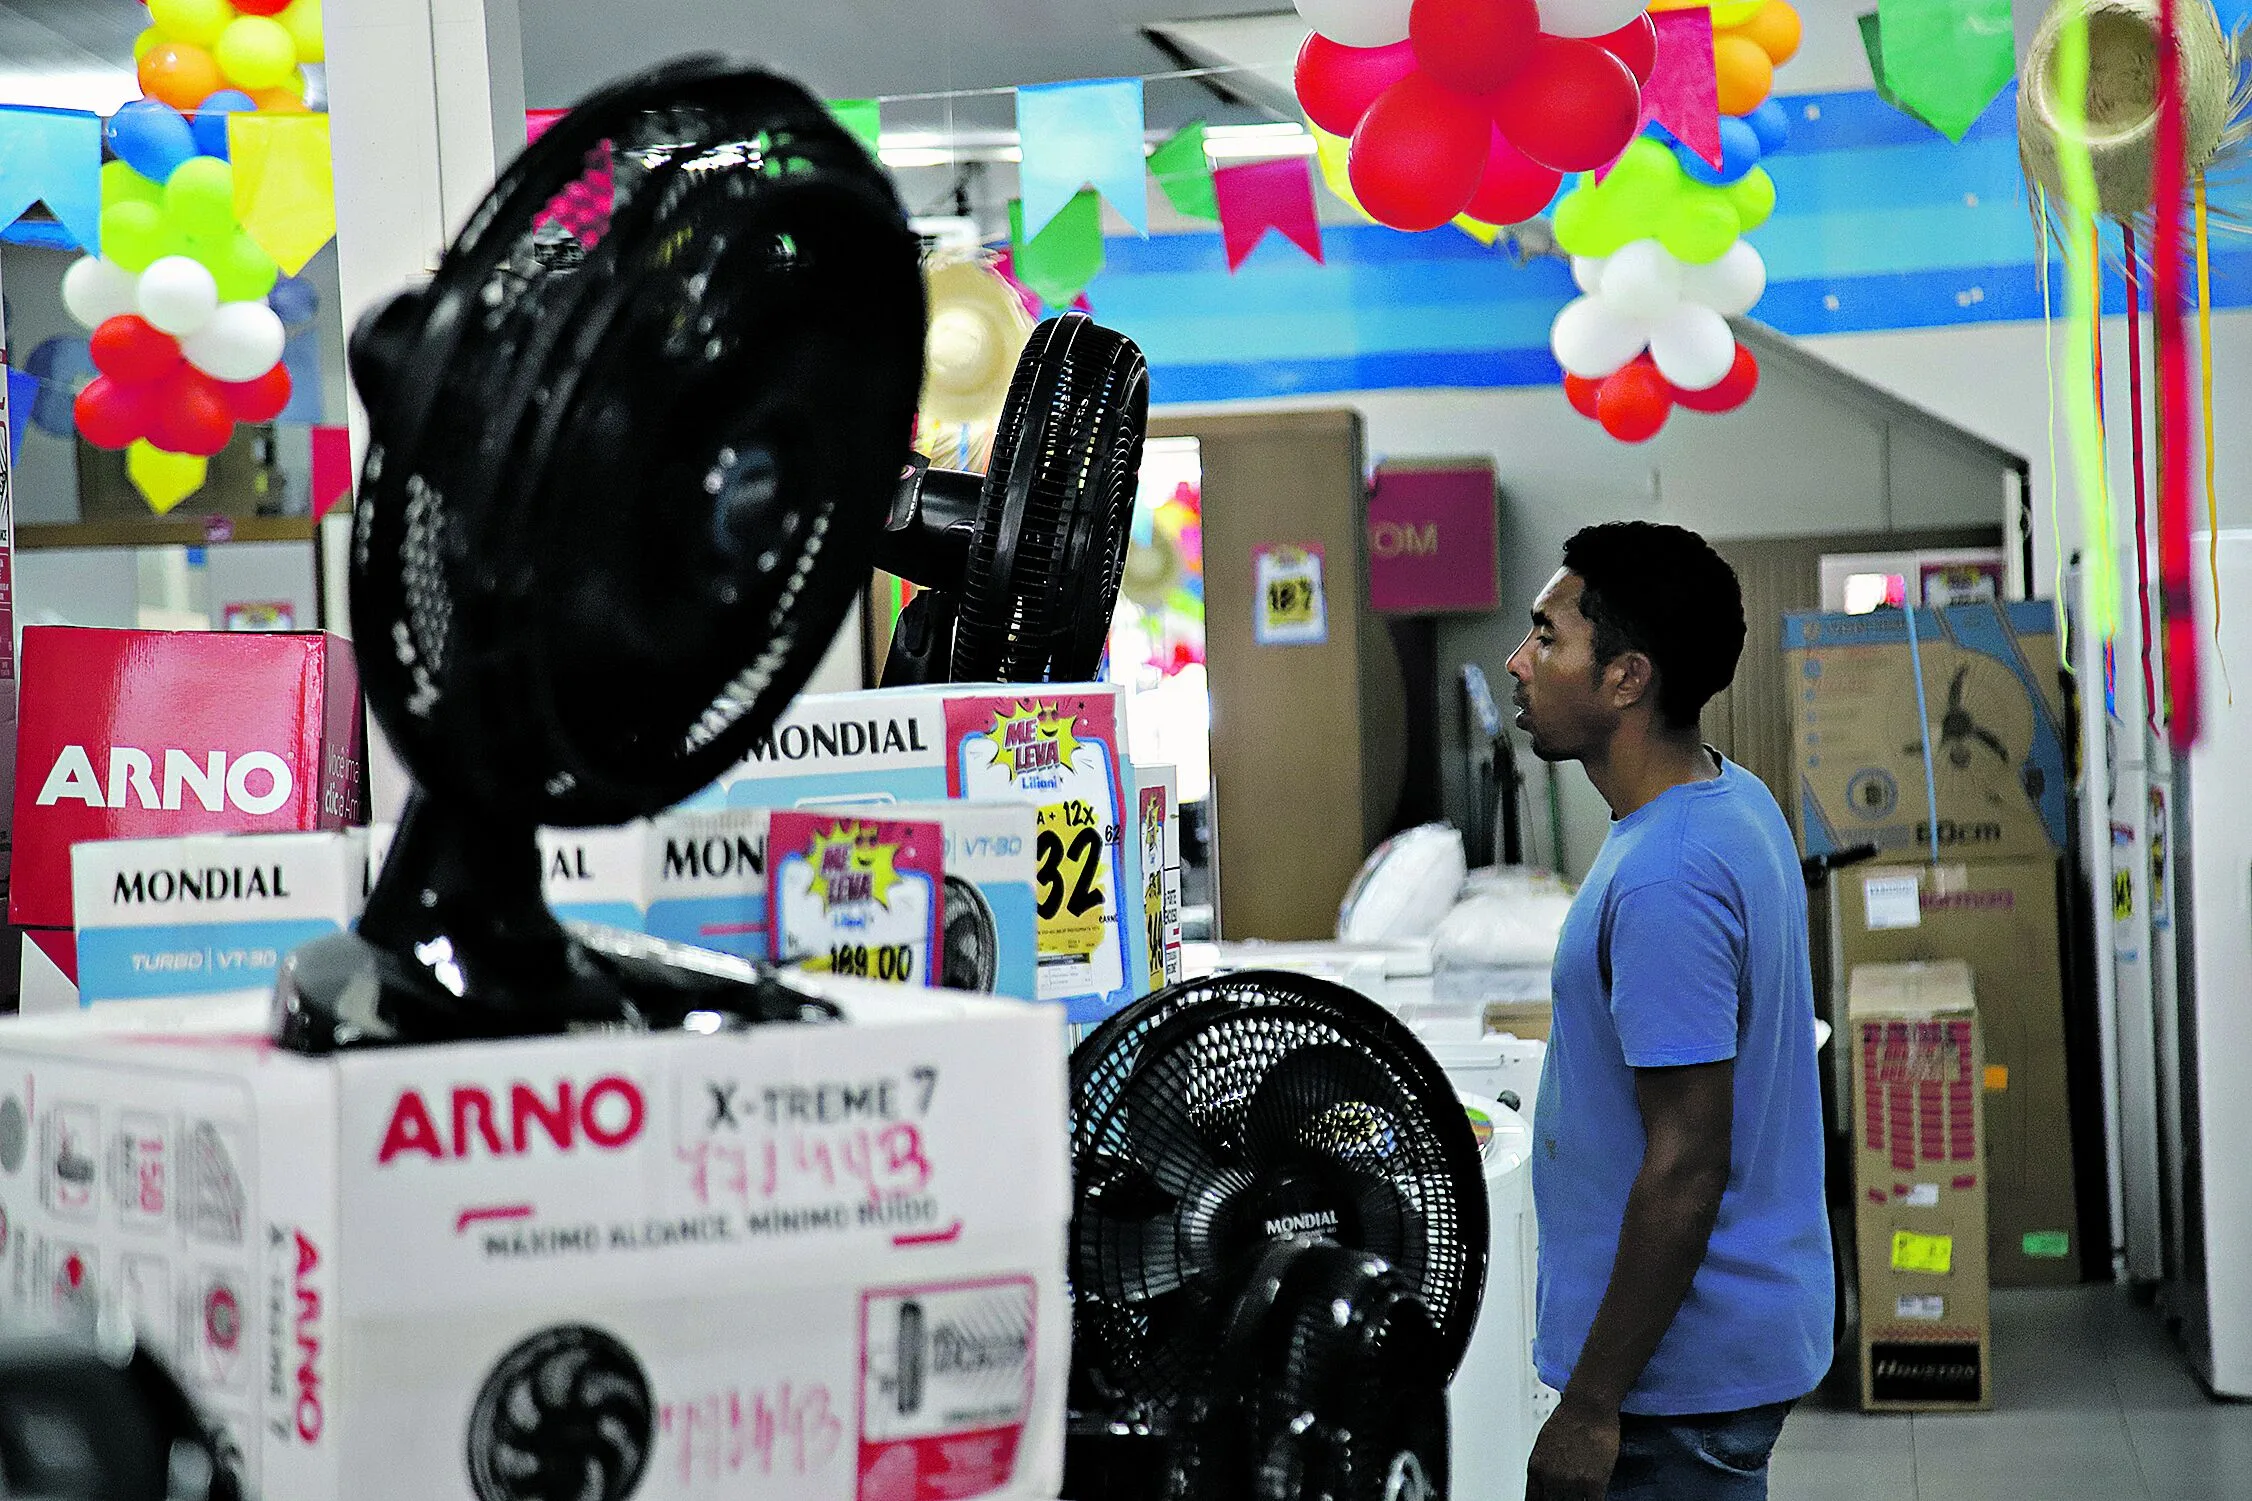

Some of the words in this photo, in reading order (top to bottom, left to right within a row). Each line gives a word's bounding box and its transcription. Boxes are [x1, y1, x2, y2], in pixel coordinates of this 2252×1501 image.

[1004, 718, 1038, 750] ME
[1014, 739, 1060, 773] LEVA
[35, 745, 294, 815] ARNO
[114, 864, 290, 905] MONDIAL
[1036, 826, 1106, 920] 32
[378, 1075, 645, 1166] ARNO
[911, 1064, 939, 1116] 7
[1265, 1209, 1339, 1236] MONDIAL
[293, 1222, 325, 1445] ARNO
